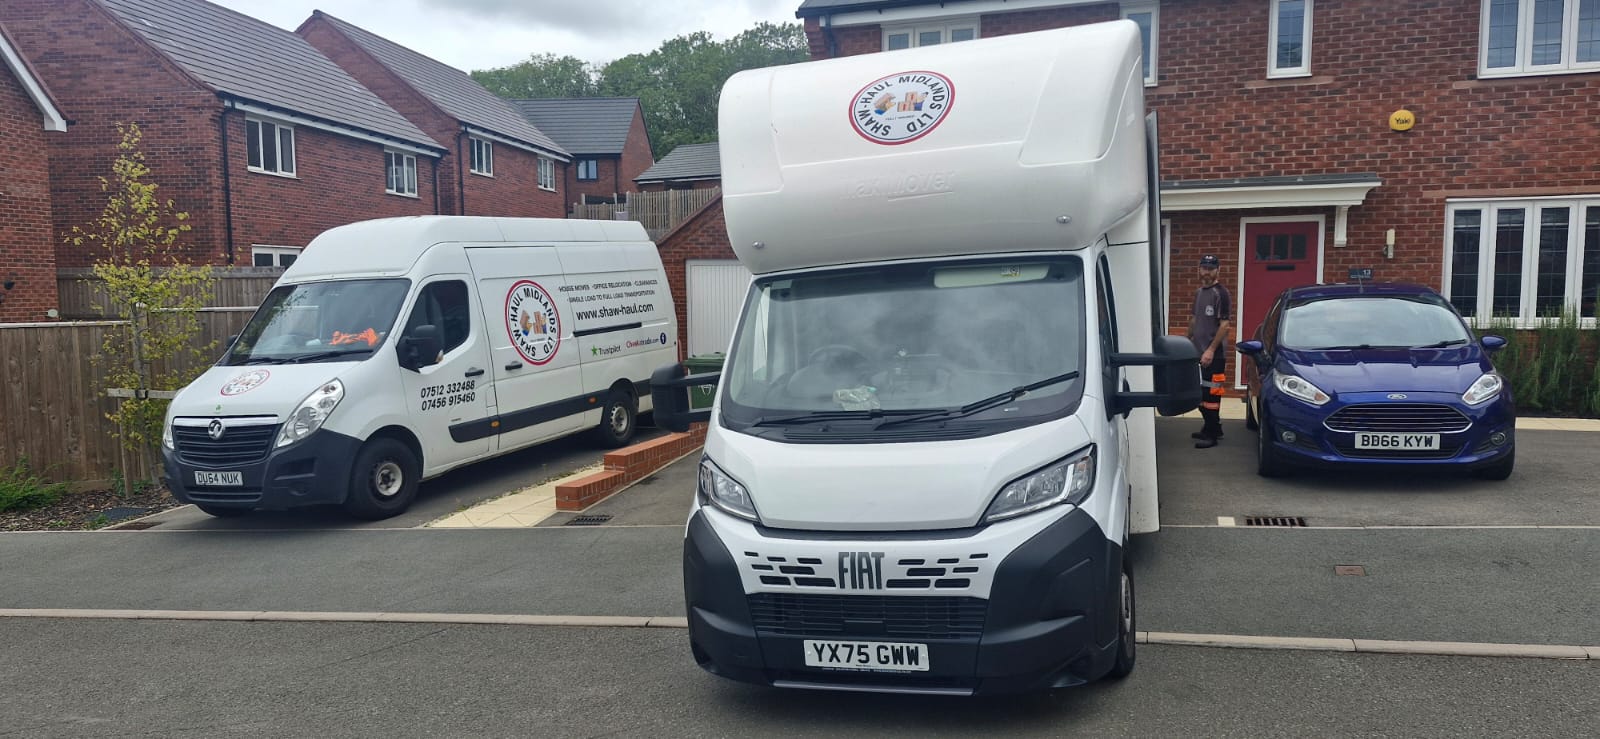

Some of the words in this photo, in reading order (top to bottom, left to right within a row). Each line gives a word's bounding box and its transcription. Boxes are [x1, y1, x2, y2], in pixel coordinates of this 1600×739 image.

[898, 75, 945, 110] MIDLANDS
[858, 81, 893, 136] SHAW-HAUL
[906, 113, 933, 133] LTD
[576, 302, 654, 321] www.shaw-haul.com
[510, 293, 536, 357] SHAW-HAUL
[523, 287, 556, 334] MIDLANDS
[543, 336, 556, 354] LTD
[598, 345, 620, 355] Trustpilot
[420, 385, 445, 398] 07512
[446, 380, 475, 394] 332488
[421, 397, 447, 411] 07456
[448, 392, 475, 406] 915460
[1361, 434, 1400, 447] BD66
[1404, 435, 1433, 447] KYW
[221, 472, 239, 484] NUK
[838, 551, 885, 590] FIAT
[813, 643, 870, 664] YX75
[876, 643, 920, 667] GWW
